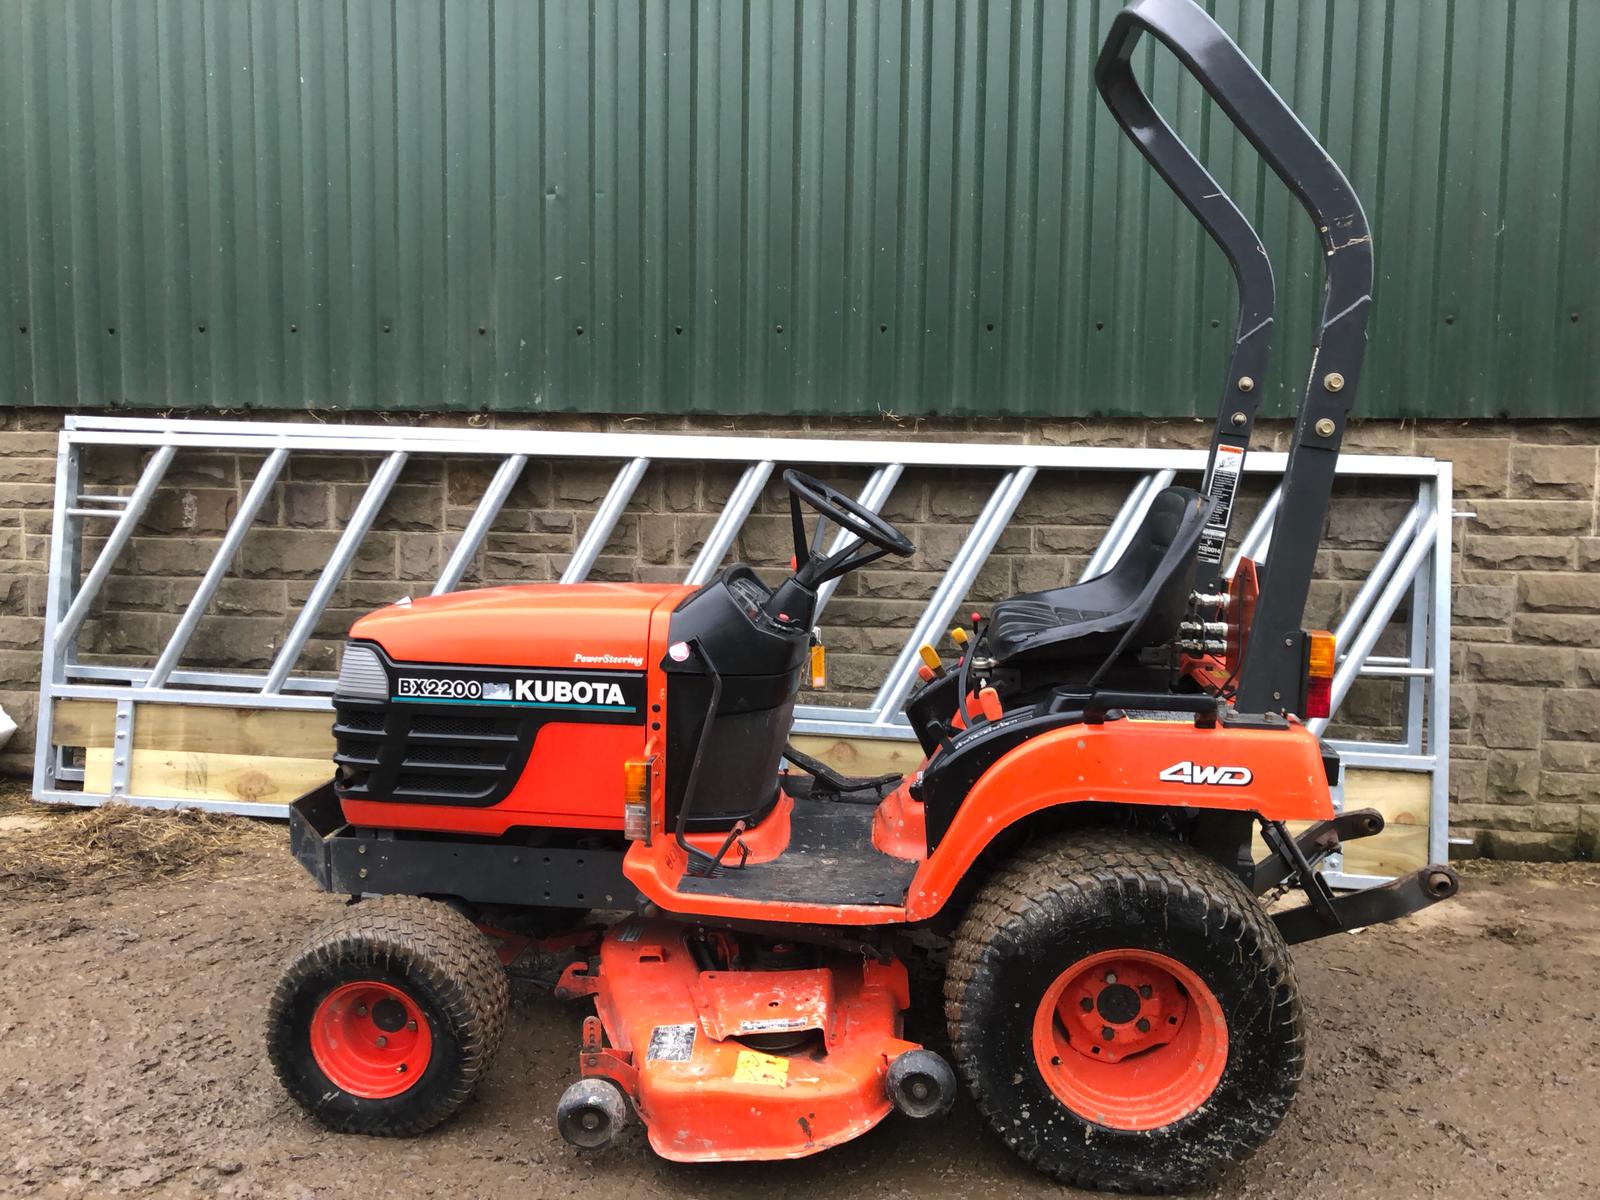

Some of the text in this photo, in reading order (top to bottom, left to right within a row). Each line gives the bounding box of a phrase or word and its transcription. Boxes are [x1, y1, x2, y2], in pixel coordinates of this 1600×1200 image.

[573, 653, 643, 666] PowerSteering
[398, 678, 482, 699] BX2200
[515, 679, 626, 705] KUBOTA
[1159, 761, 1253, 786] 4WD
